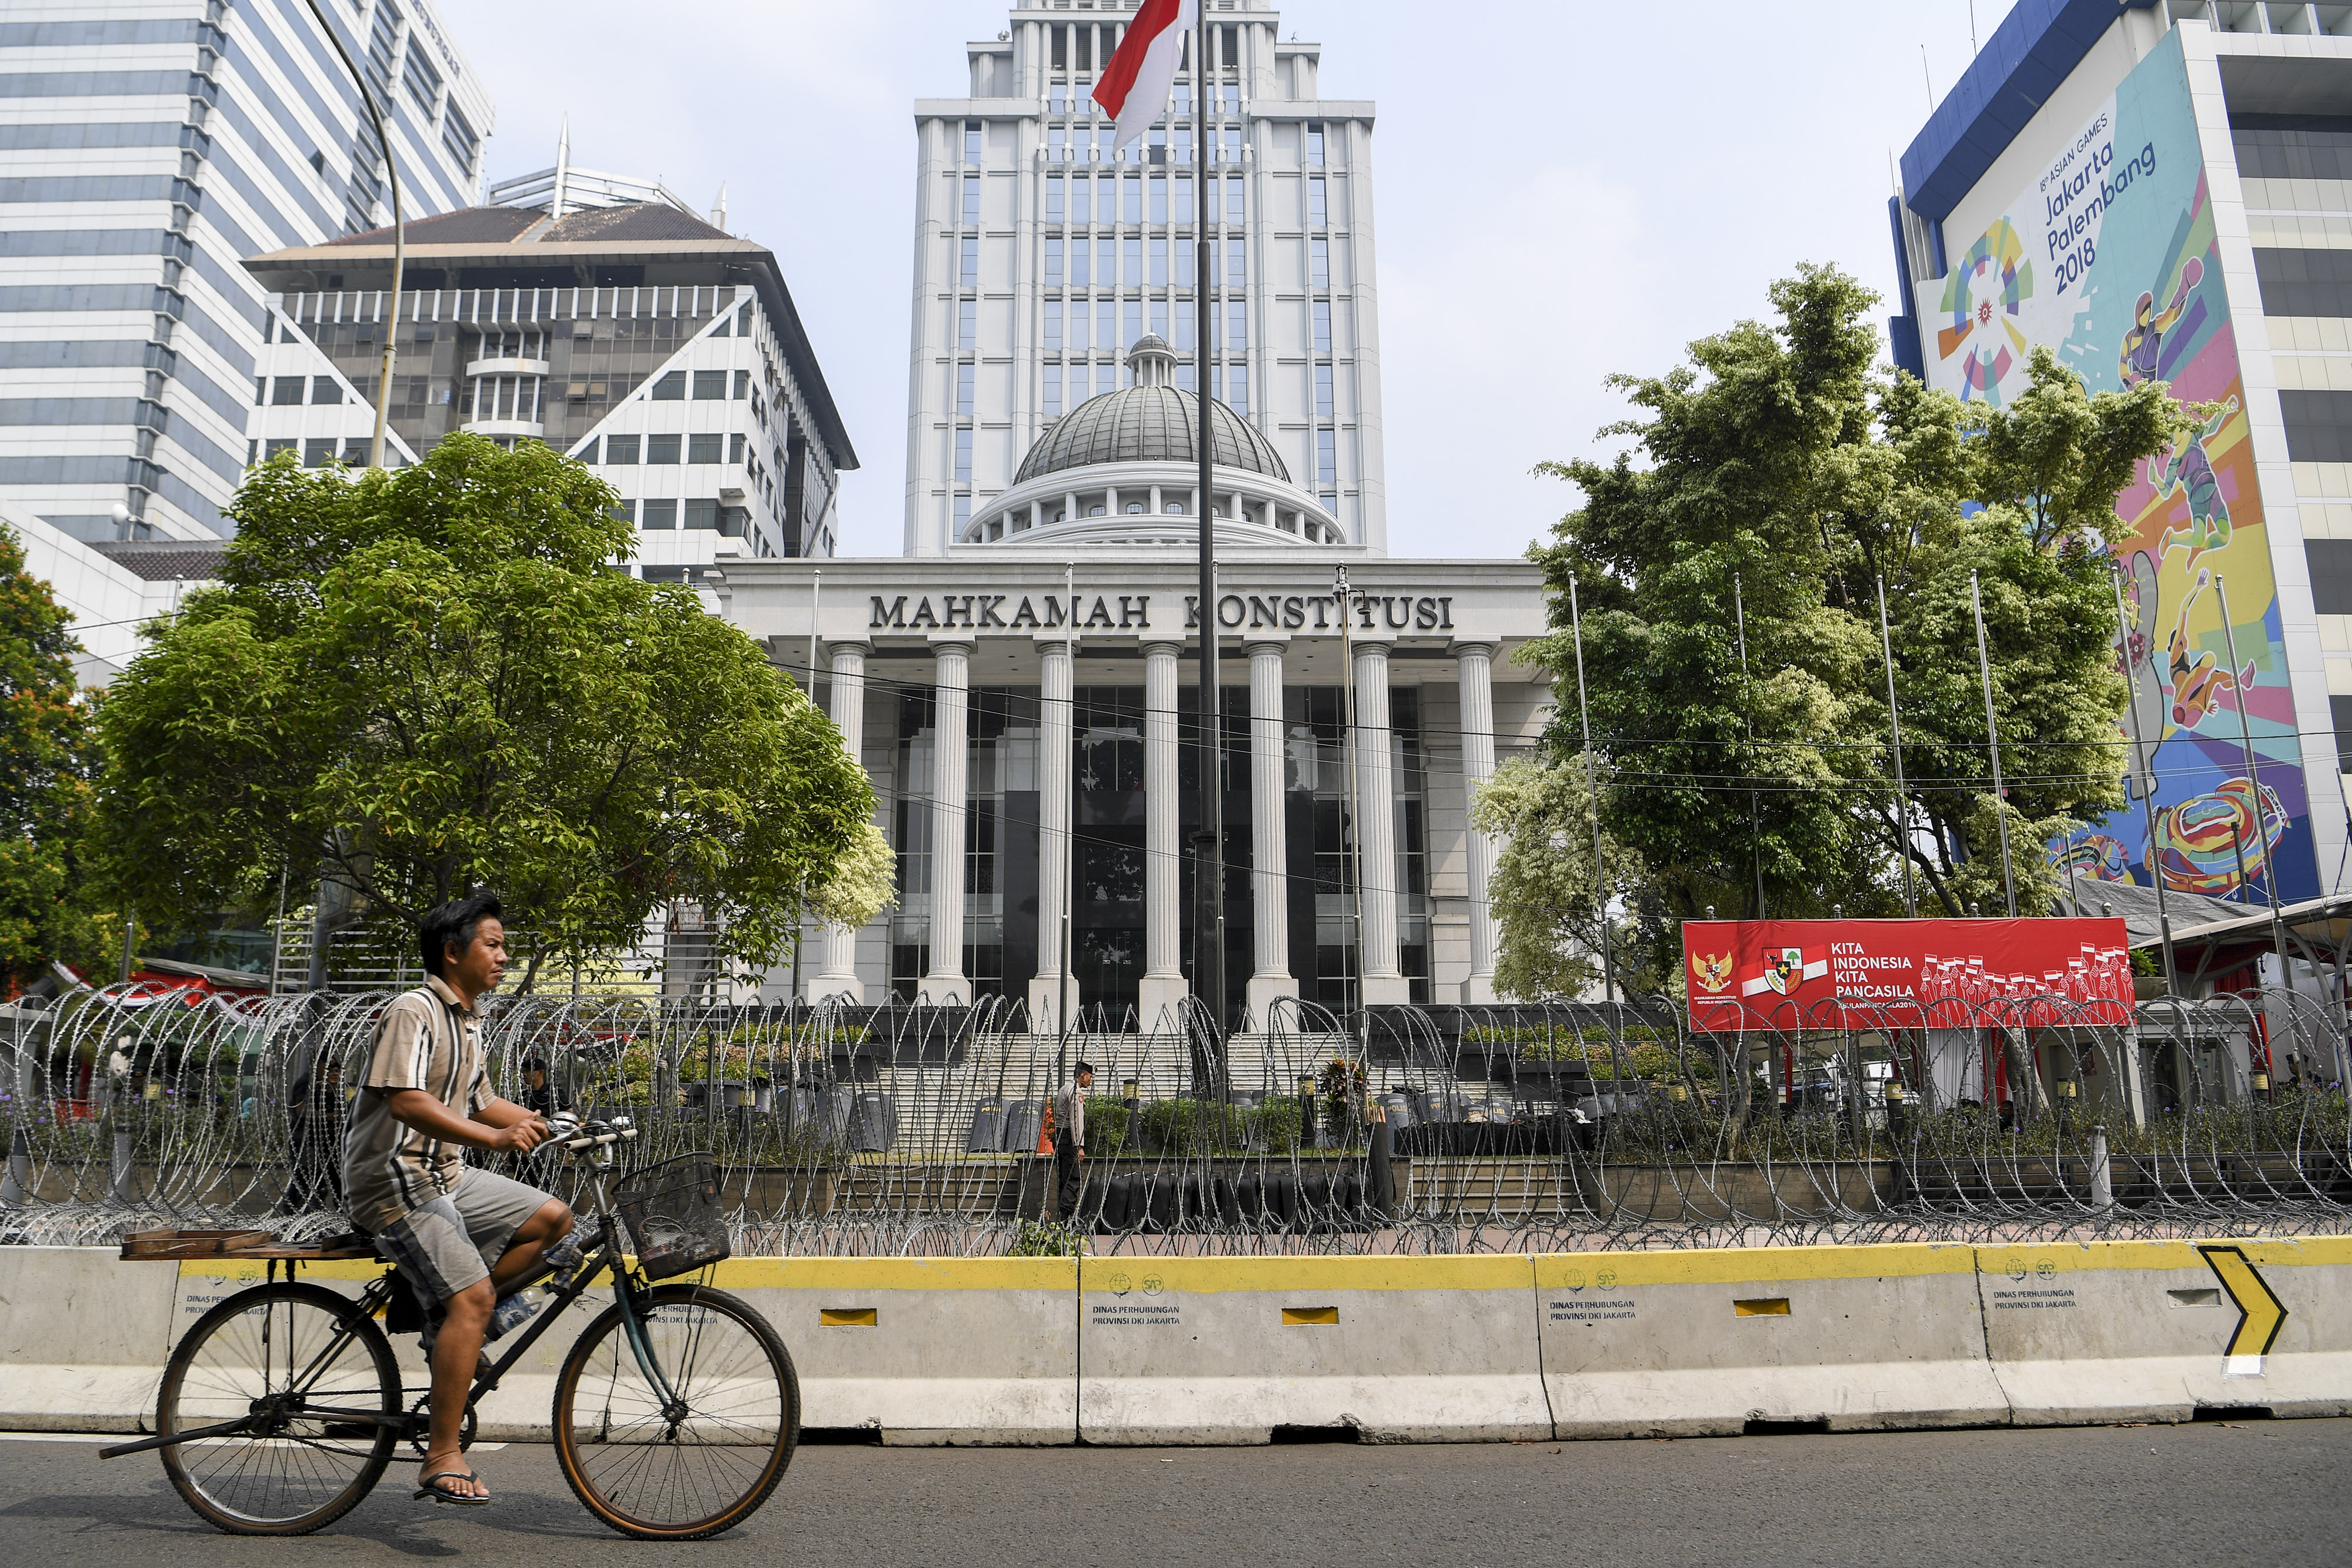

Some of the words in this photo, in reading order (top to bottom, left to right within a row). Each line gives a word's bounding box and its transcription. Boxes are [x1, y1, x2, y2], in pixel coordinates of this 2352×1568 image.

[2050, 148, 2075, 185] ASIAN
[2077, 113, 2108, 153] GAMES
[2046, 141, 2114, 226] Jakarta
[2047, 141, 2156, 262] Palembang
[2054, 238, 2096, 296] 2018
[869, 595, 1151, 627] MAHKAMAH
[1184, 594, 1455, 628] KONSTTUSI
[1831, 942, 1865, 955] KITA
[1833, 957, 1912, 969] INDONESIA
[1835, 971, 1868, 983] KITA
[1836, 985, 1915, 998] PANCASILA
